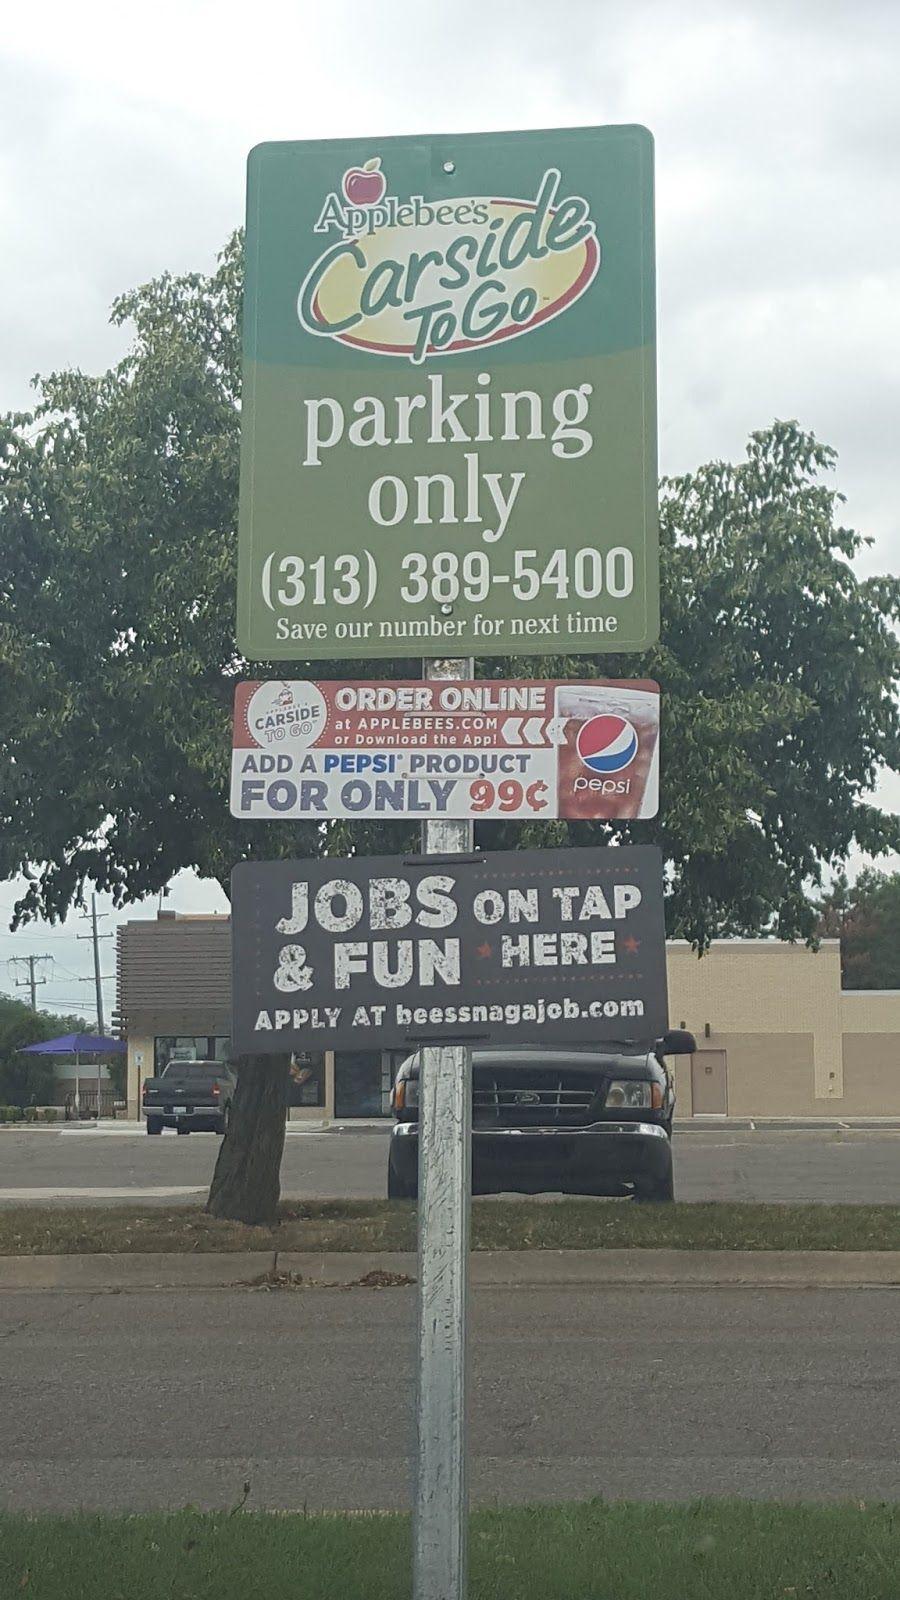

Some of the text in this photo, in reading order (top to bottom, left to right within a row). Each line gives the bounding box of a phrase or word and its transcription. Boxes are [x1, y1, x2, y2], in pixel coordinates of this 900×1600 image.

[314, 194, 489, 237] Applebee's
[299, 170, 594, 336] Carside
[302, 373, 593, 466] parking
[368, 453, 526, 543] only
[261, 547, 633, 611] (313) 389-5400
[276, 612, 618, 640] Save our number for next time
[335, 687, 435, 711] ORDER
[439, 686, 546, 711] ONLINE
[255, 705, 320, 730] CARSIDE
[265, 721, 312, 742] TO GO
[335, 717, 498, 730] at APPLEBEES.COM
[335, 732, 498, 746] or Download the App!
[241, 754, 293, 774] ADD
[300, 754, 317, 774] A
[410, 753, 531, 774] PRODUCT
[241, 778, 549, 813] FOR ONLY 99¢
[574, 777, 630, 795] pepsi
[274, 875, 643, 935] JOBS ON TAP
[273, 931, 617, 993] & FUN HERE
[254, 998, 644, 1031] APPLY AT beessnagajob.com
